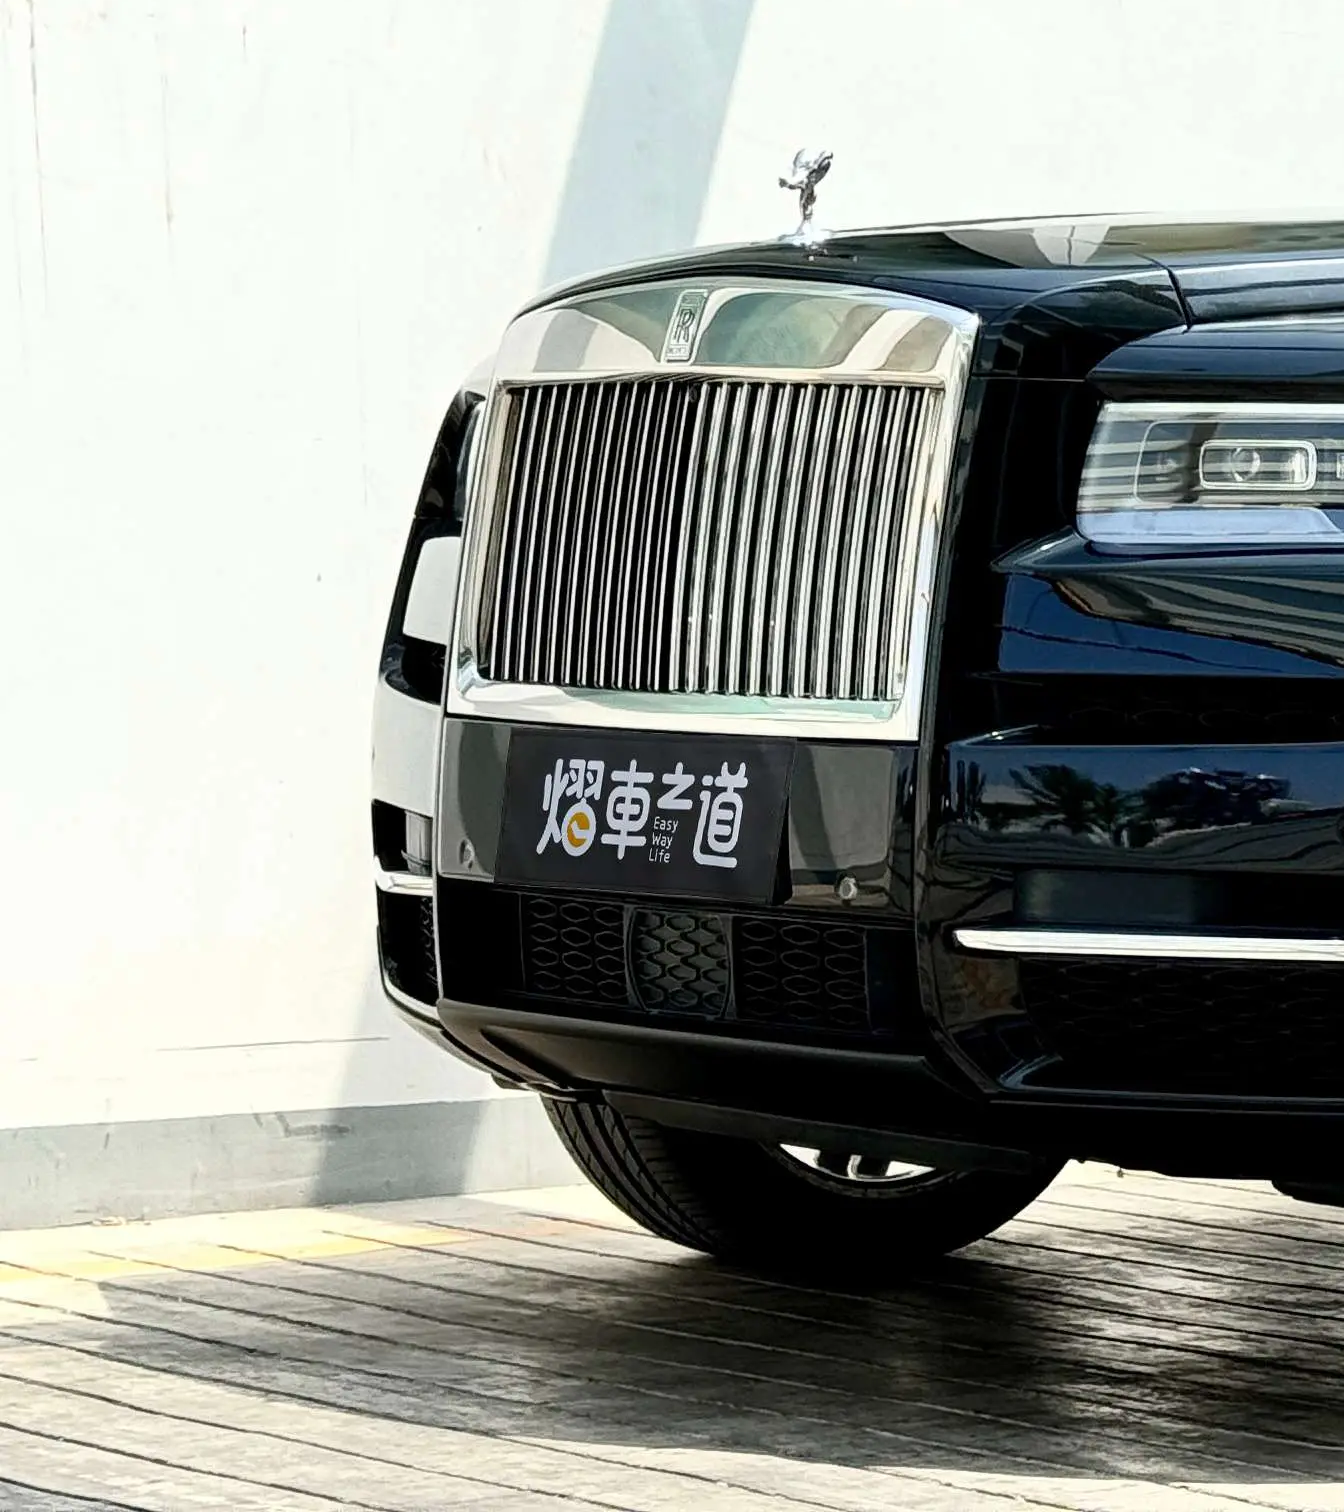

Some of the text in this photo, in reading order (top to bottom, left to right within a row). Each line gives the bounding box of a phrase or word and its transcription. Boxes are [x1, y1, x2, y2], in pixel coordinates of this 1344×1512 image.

[654, 816, 678, 833] Easy
[652, 832, 673, 849] Way
[649, 848, 670, 863] Life
